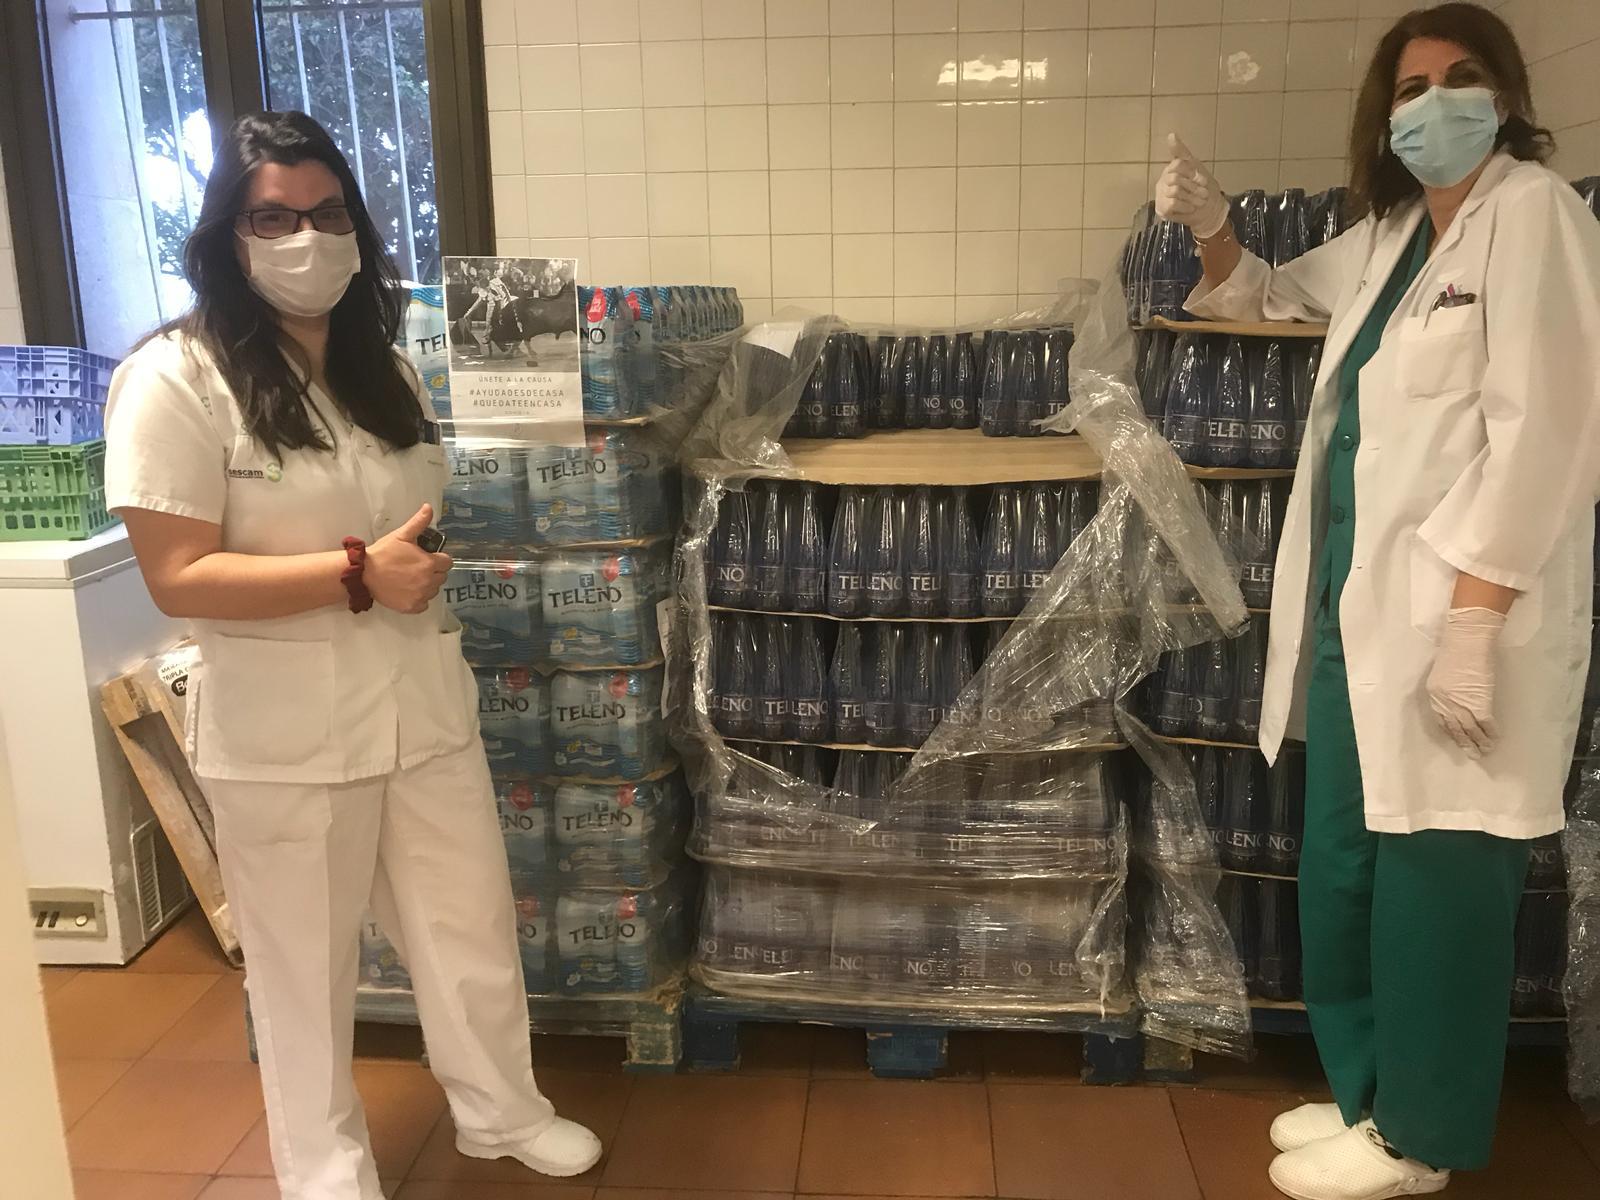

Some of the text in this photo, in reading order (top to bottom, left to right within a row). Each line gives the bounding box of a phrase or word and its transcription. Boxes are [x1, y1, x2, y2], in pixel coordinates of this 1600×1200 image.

[527, 376, 552, 384] CAUSA
[469, 388, 565, 397] #AYUDADESDECASA
[473, 399, 562, 408] #QUEDATEENCASA
[228, 468, 264, 477] sescam
[453, 459, 499, 476] ENO
[536, 458, 606, 483] TELENO
[443, 583, 517, 603] TELENO
[548, 586, 622, 608] TELENO
[556, 701, 626, 722] TELENO
[562, 810, 632, 831] TELENO
